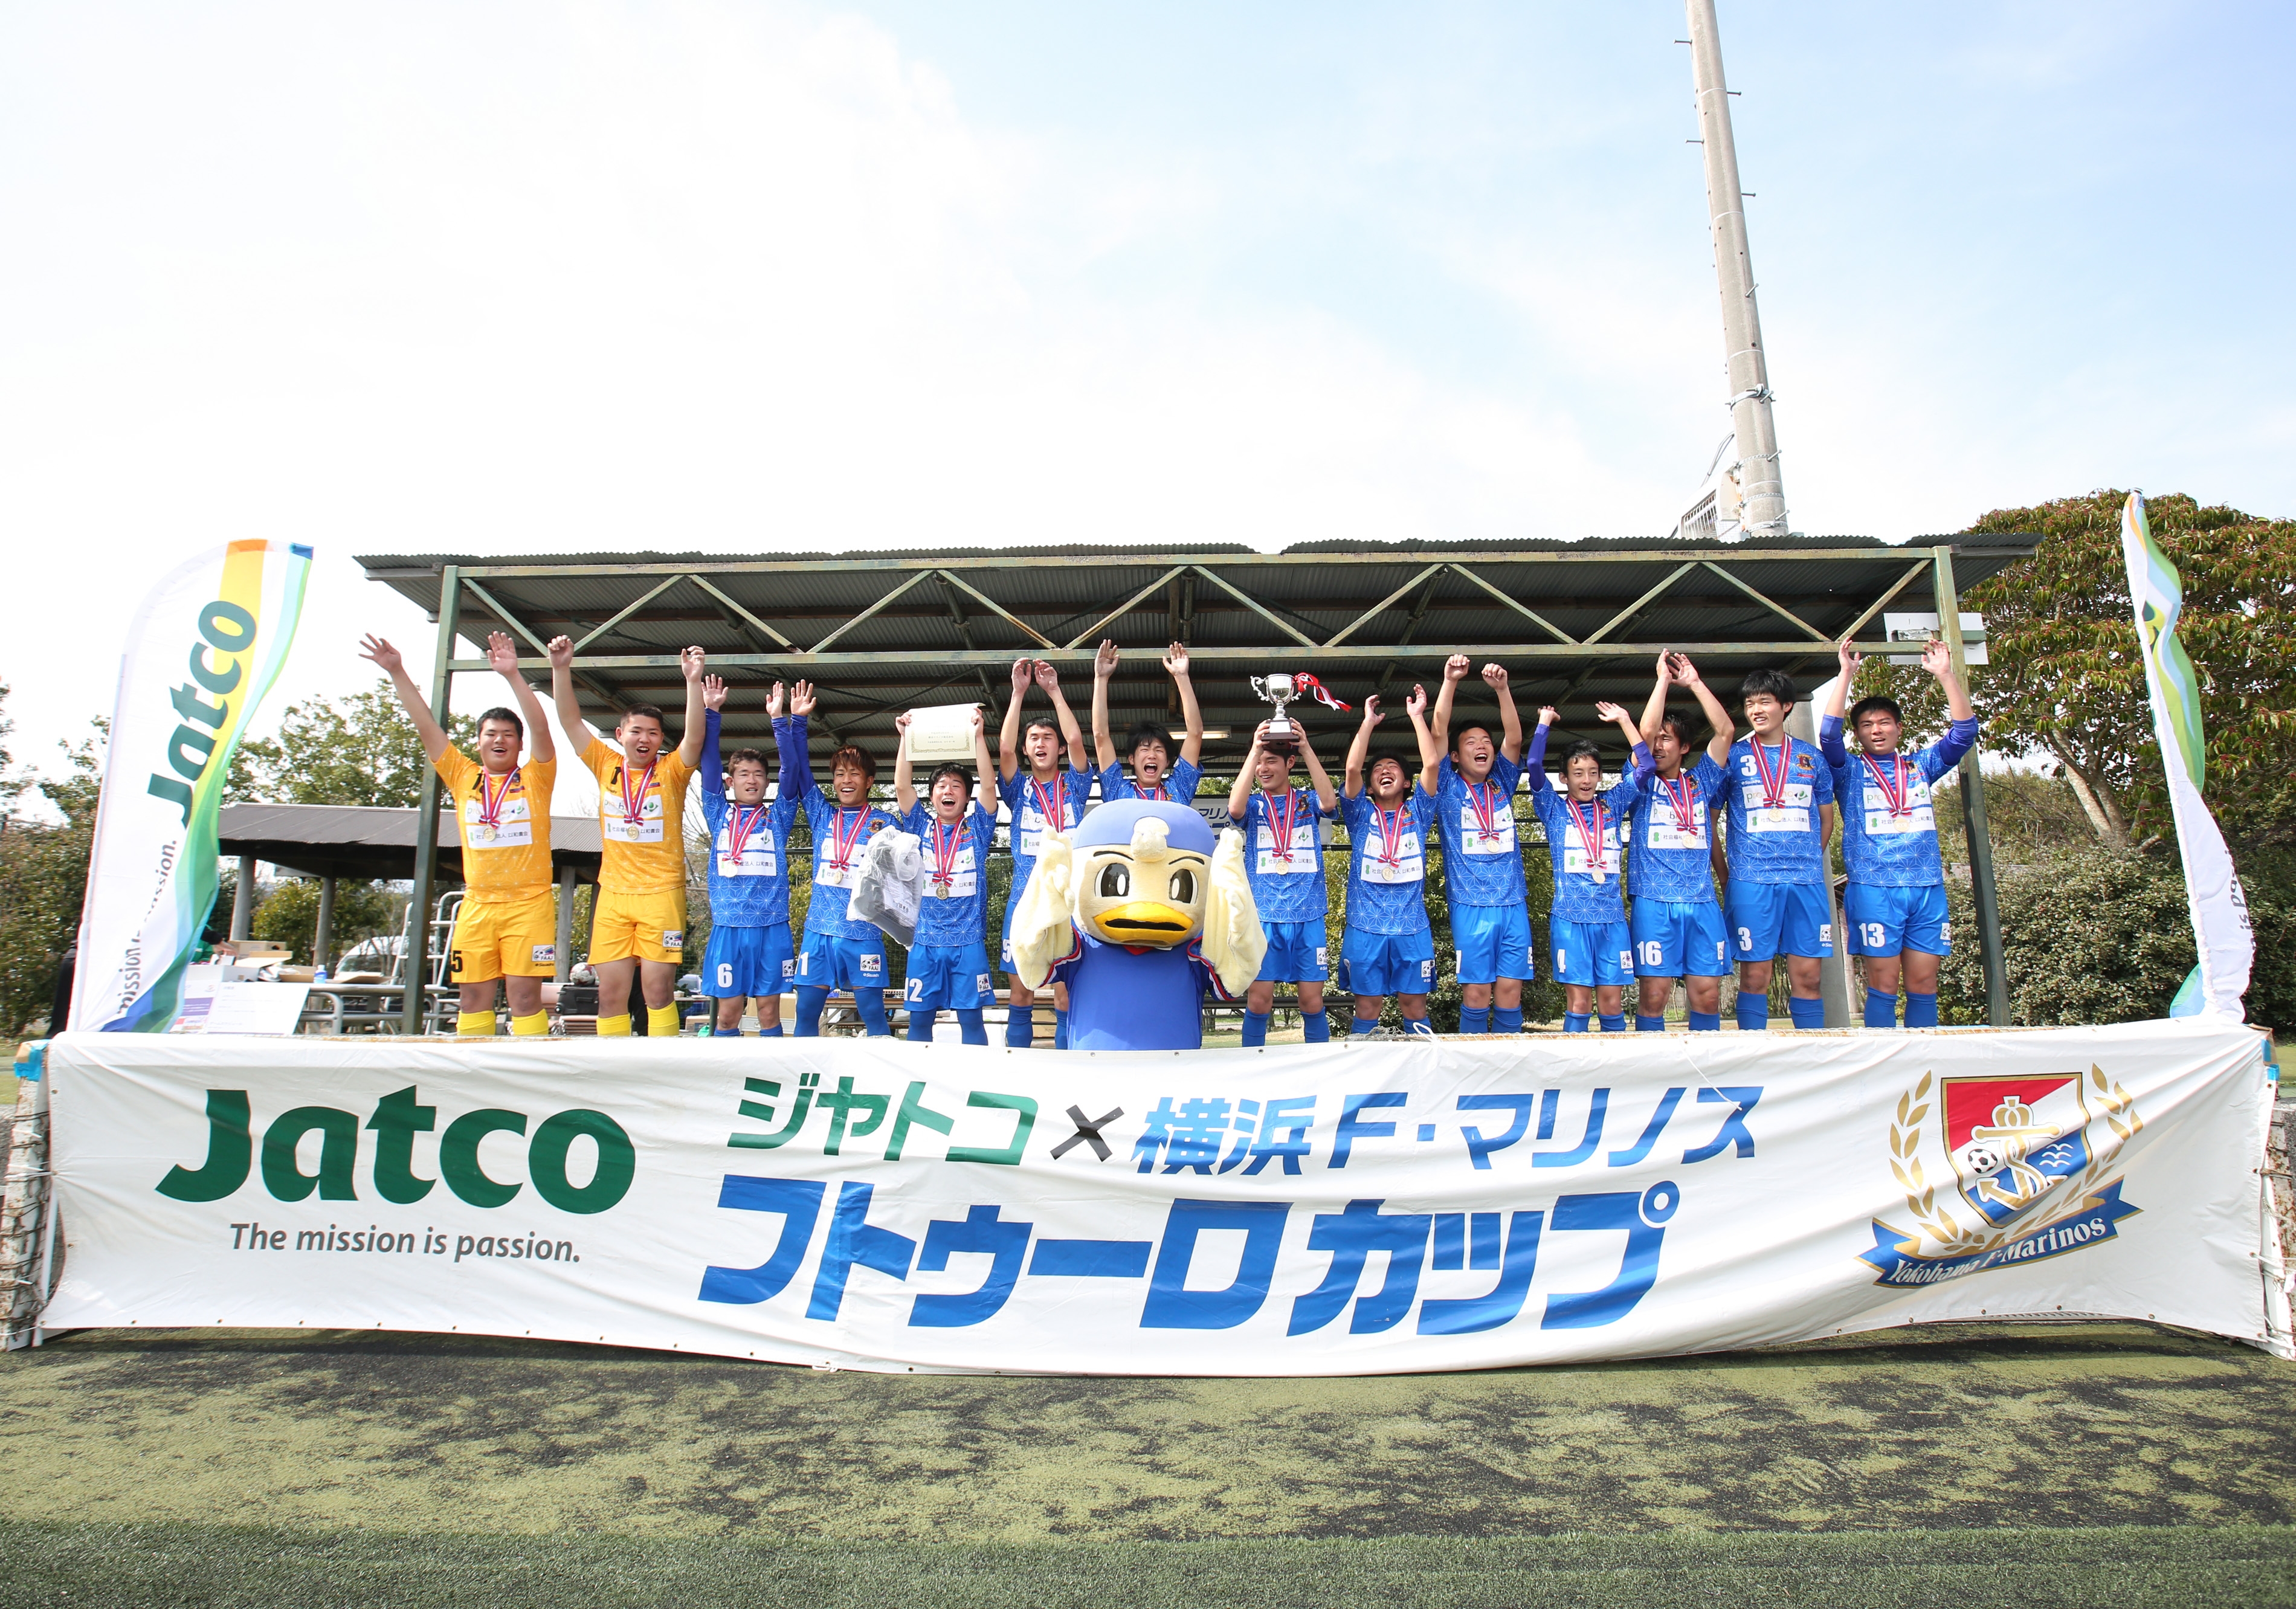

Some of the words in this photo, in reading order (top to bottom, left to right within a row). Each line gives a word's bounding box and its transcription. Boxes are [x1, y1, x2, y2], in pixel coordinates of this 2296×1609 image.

[147, 601, 257, 829] Jatco
[1740, 755, 1758, 776] 3
[1738, 927, 1752, 951] 3
[1859, 923, 1885, 948] 13
[1637, 941, 1662, 966] 16
[717, 963, 733, 988] 6
[155, 1085, 635, 1214] Jatco
[230, 1222, 286, 1250] The
[296, 1225, 415, 1254] mission
[424, 1227, 447, 1254] is
[454, 1229, 580, 1263] passion.
[1888, 1257, 1981, 1284] Yokohama
